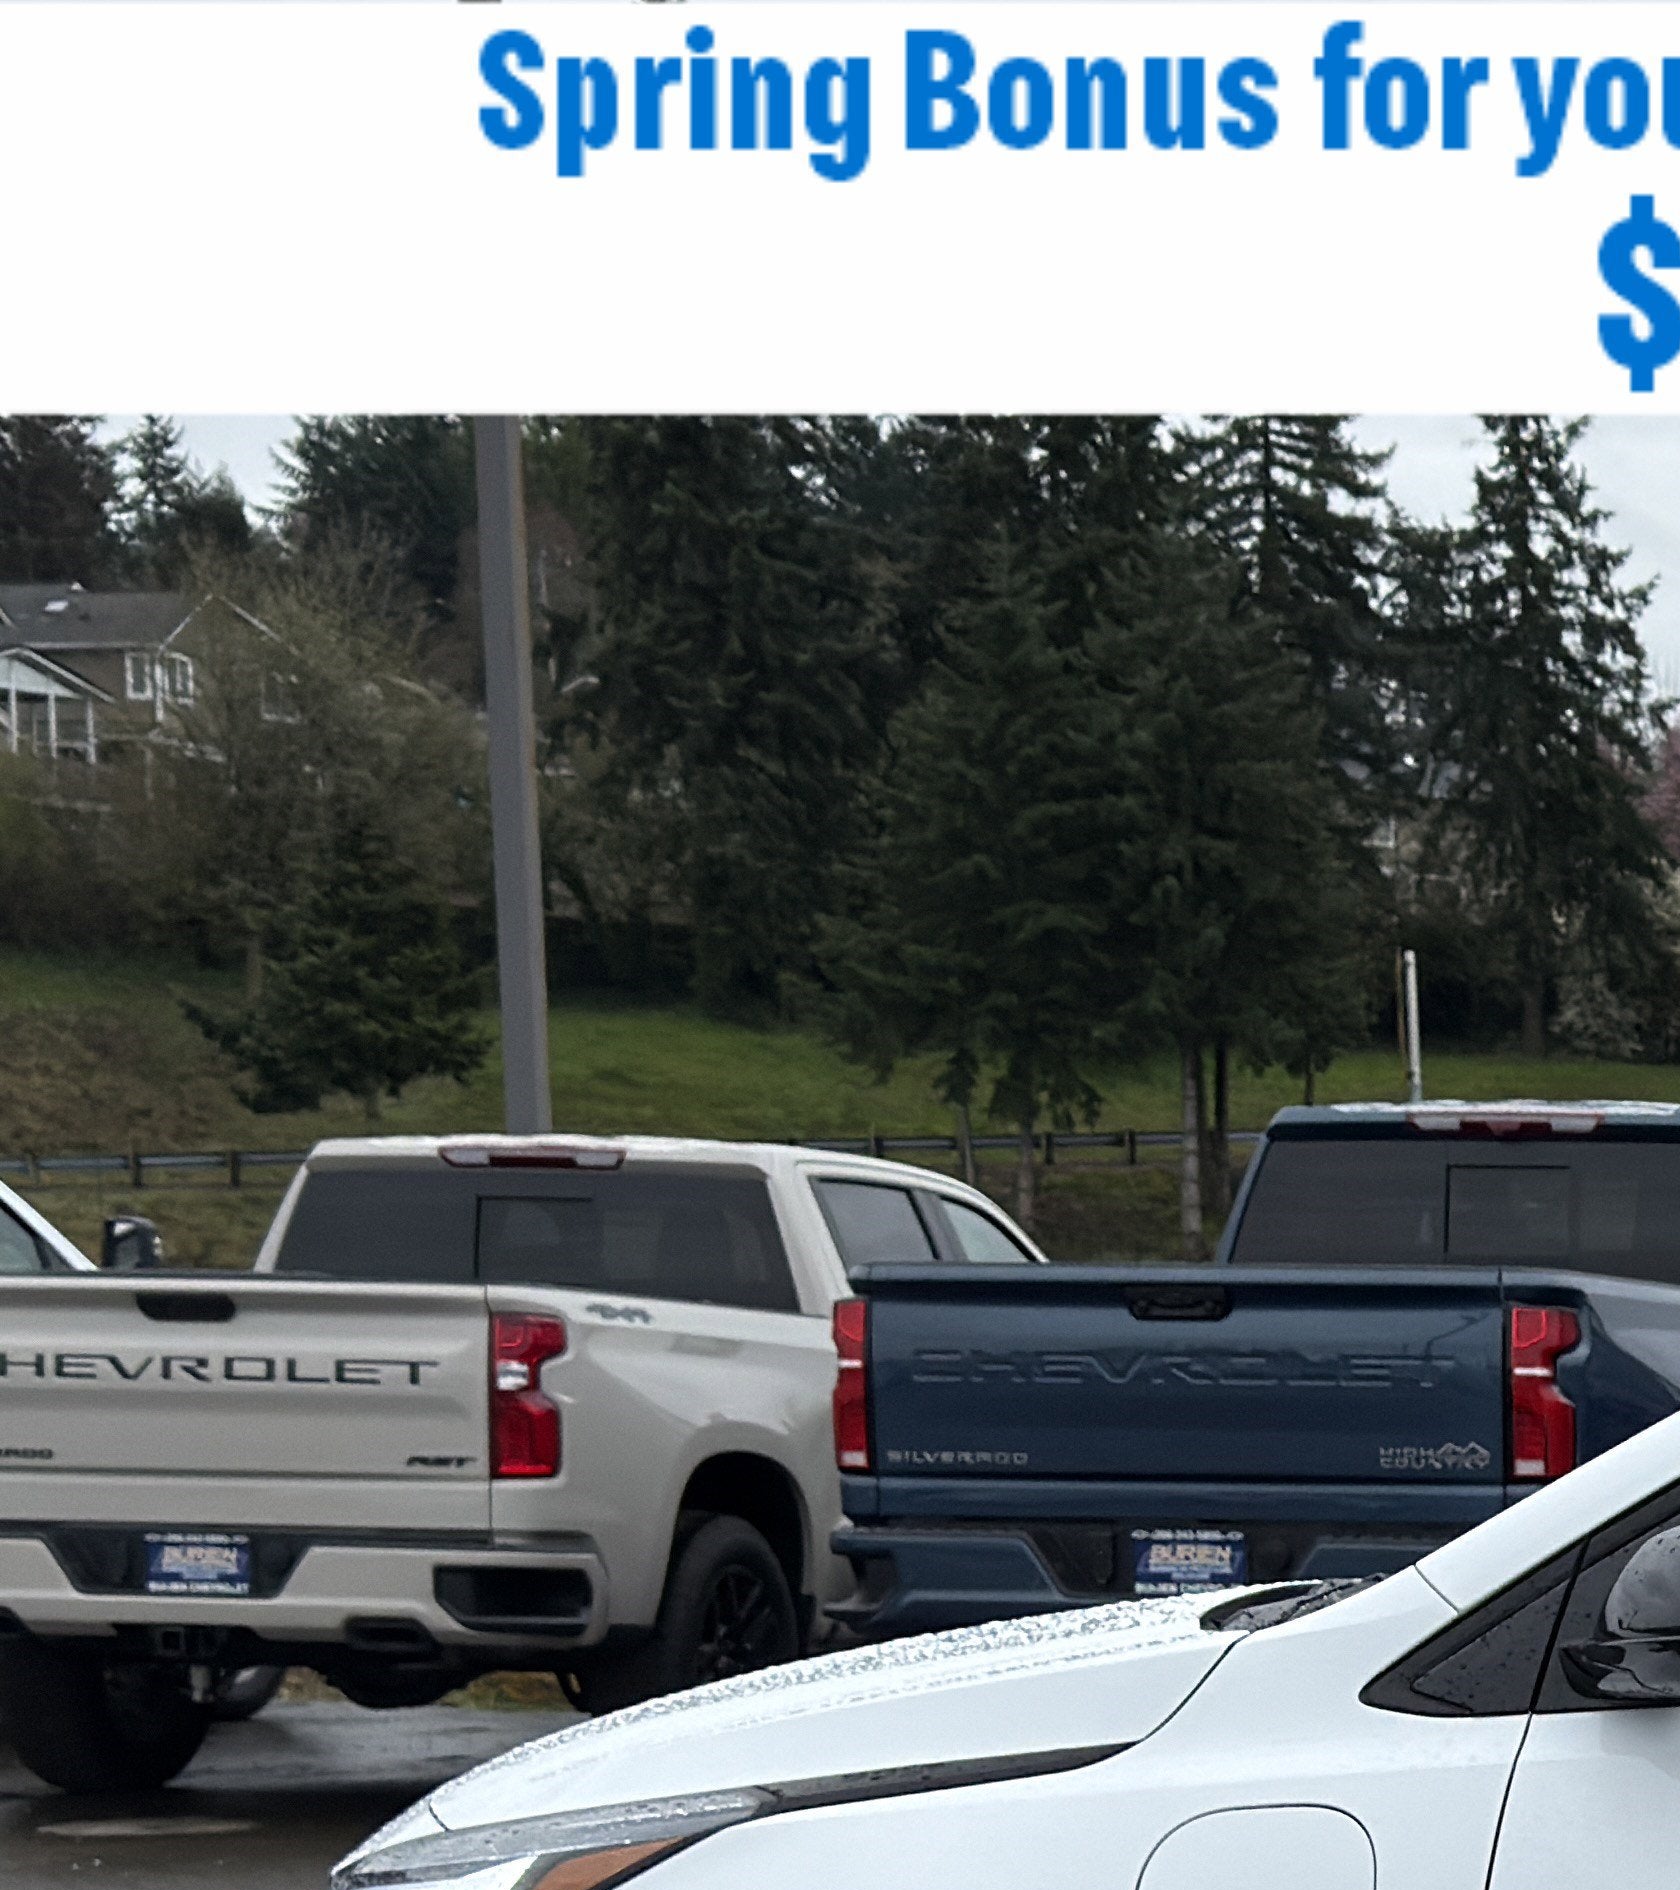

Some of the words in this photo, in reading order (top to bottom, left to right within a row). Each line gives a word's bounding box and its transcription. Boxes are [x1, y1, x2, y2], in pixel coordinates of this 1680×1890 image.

[0, 1353, 439, 1386] HEVROLET
[910, 1350, 1456, 1388] CHEVROLET
[886, 1450, 1029, 1465] SILVERADO
[1149, 1544, 1231, 1564] BURIEN
